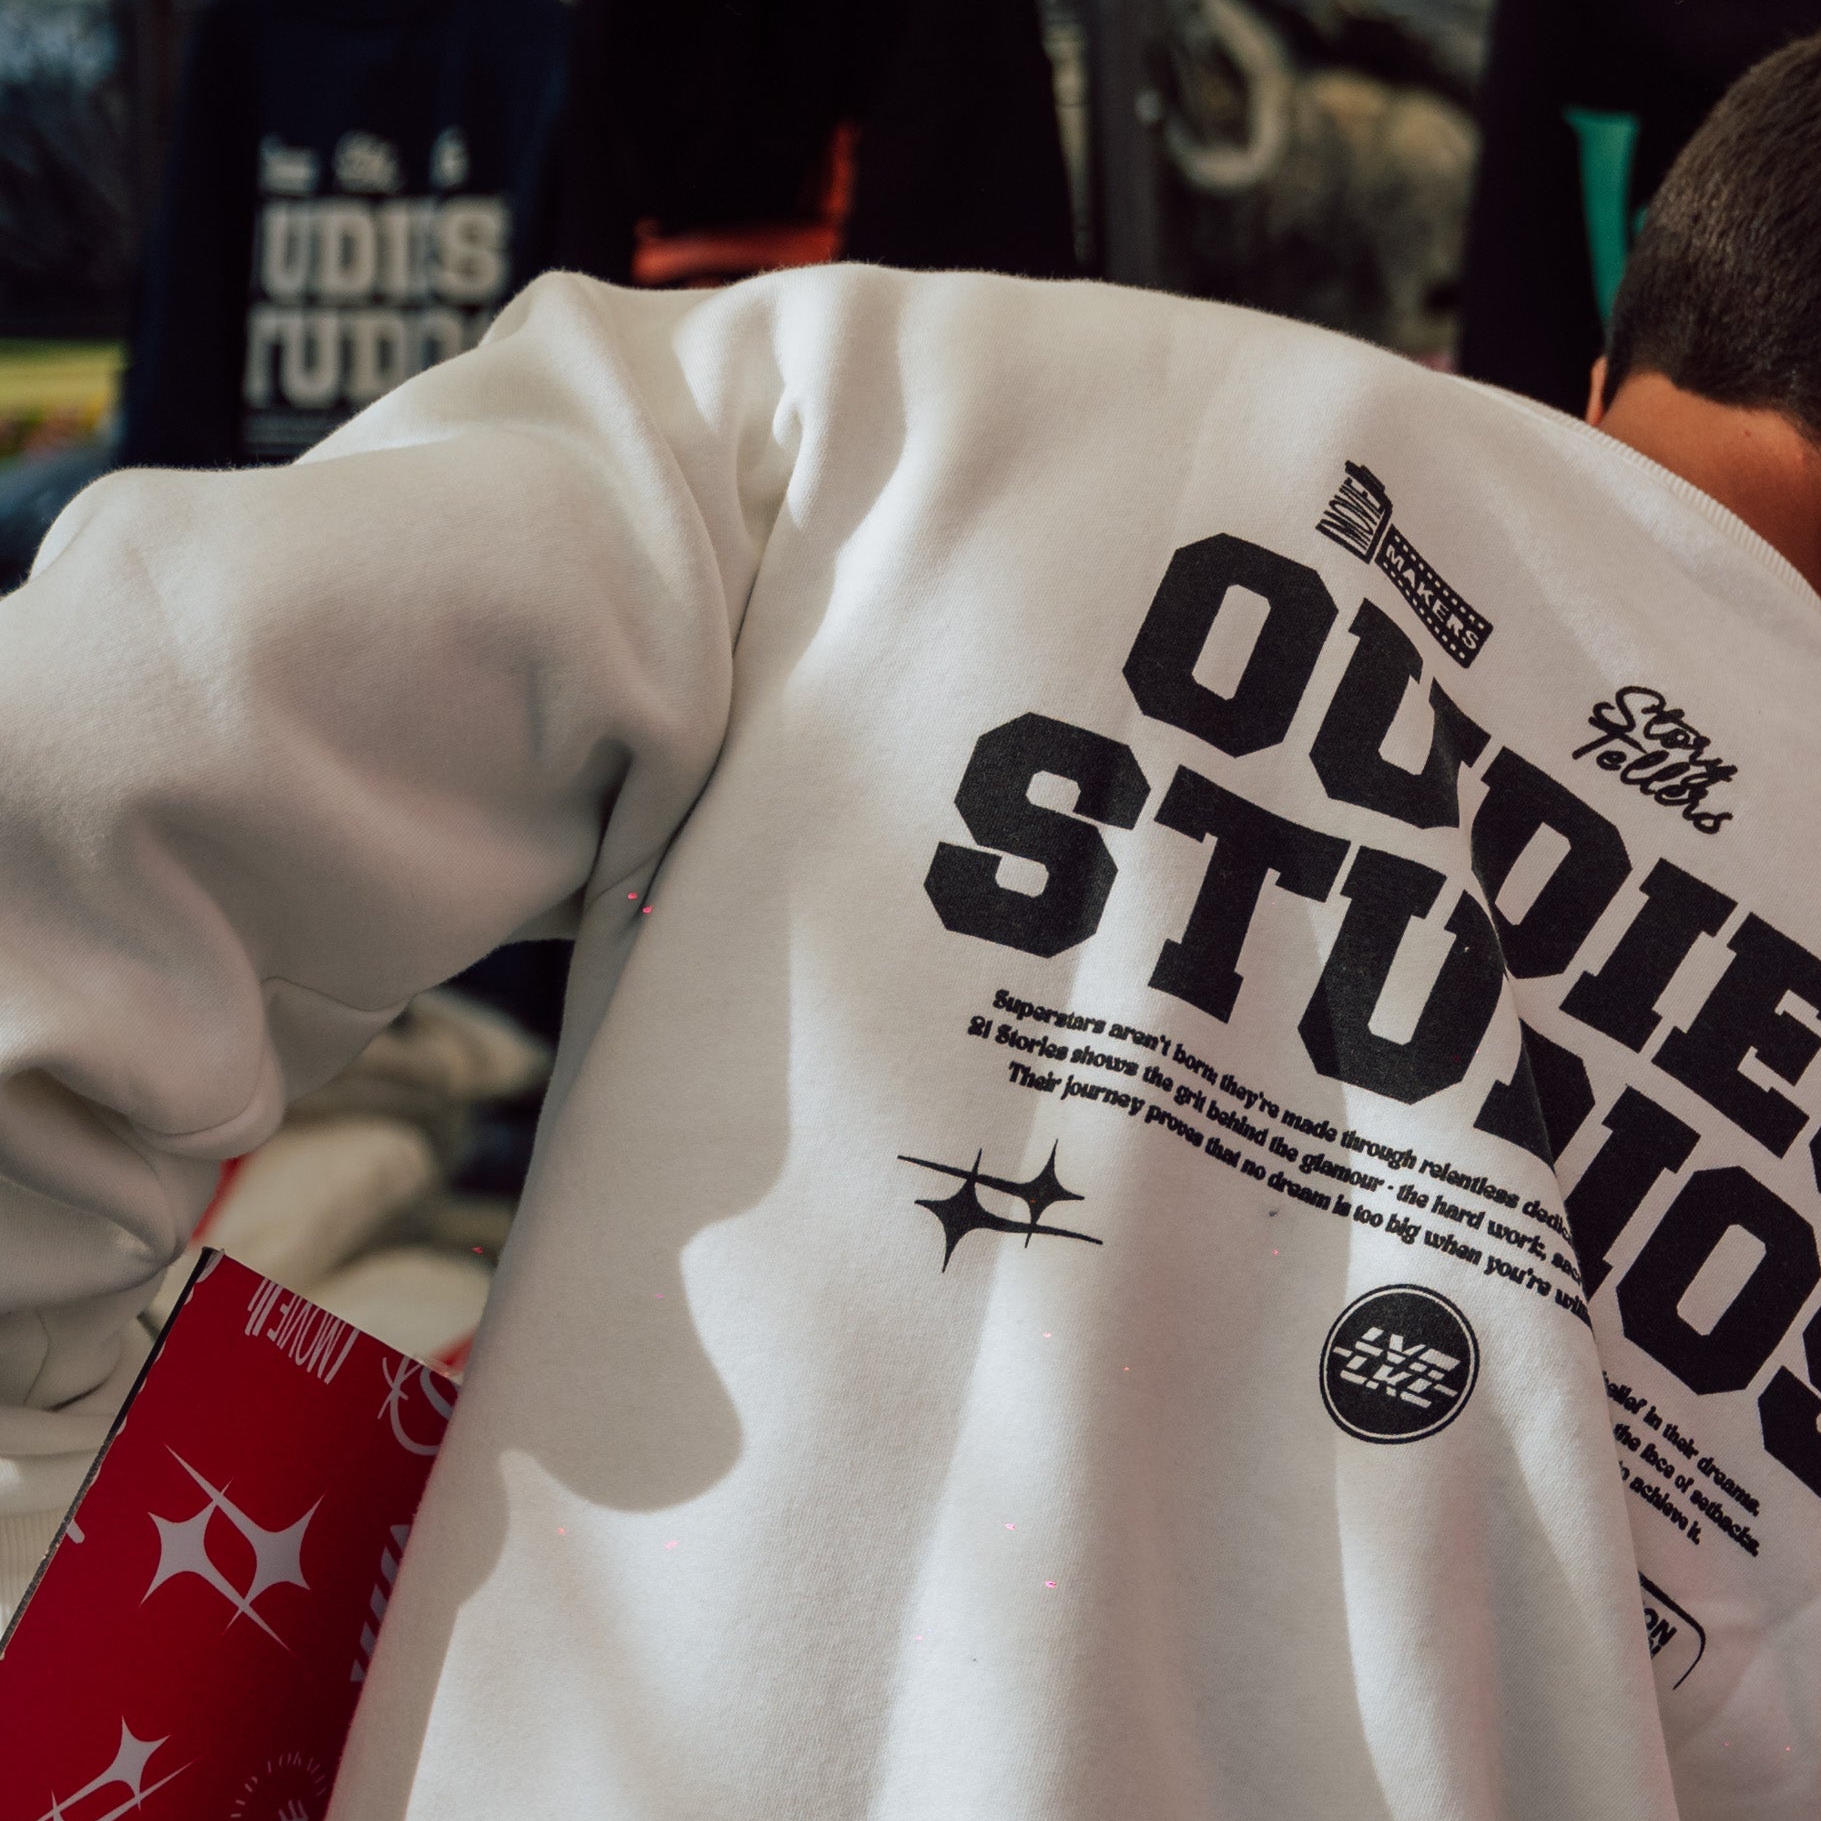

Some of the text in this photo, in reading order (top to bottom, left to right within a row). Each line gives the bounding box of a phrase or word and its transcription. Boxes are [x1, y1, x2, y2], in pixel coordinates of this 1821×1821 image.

[1386, 545, 1479, 650] MAKERS
[992, 989, 1106, 1034] Superstars
[1109, 1022, 1171, 1056] aren't
[1219, 1073, 1280, 1119] they're
[1281, 1109, 1338, 1142] made
[1340, 1130, 1417, 1170] through
[1418, 1158, 1521, 1209] relentless
[1643, 1406, 1663, 1430] in
[1662, 1423, 1700, 1460] their
[995, 1024, 1069, 1061] Stories
[1070, 1045, 1139, 1077] shows
[1142, 1066, 1173, 1092] the
[1173, 1083, 1207, 1113] grit
[1206, 1099, 1269, 1147] behind
[1268, 1135, 1299, 1162] the
[1299, 1153, 1385, 1192] glamour
[1396, 1184, 1430, 1209] the
[1431, 1195, 1486, 1230] hard
[1613, 1423, 1642, 1453] the
[1640, 1443, 1676, 1479] face
[1674, 1473, 1694, 1494] of
[1008, 1060, 1062, 1093] Their
[1060, 1074, 1145, 1116] journey
[1144, 1104, 1204, 1147] proves
[1204, 1136, 1241, 1168] that
[1240, 1159, 1267, 1181] no
[1267, 1171, 1332, 1211] dream
[1332, 1194, 1352, 1217] is
[1353, 1204, 1383, 1228] too
[1385, 1213, 1422, 1245] big
[1424, 1229, 1483, 1265] when
[1484, 1255, 1552, 1297] you're
[1629, 1476, 1690, 1531] achieve
